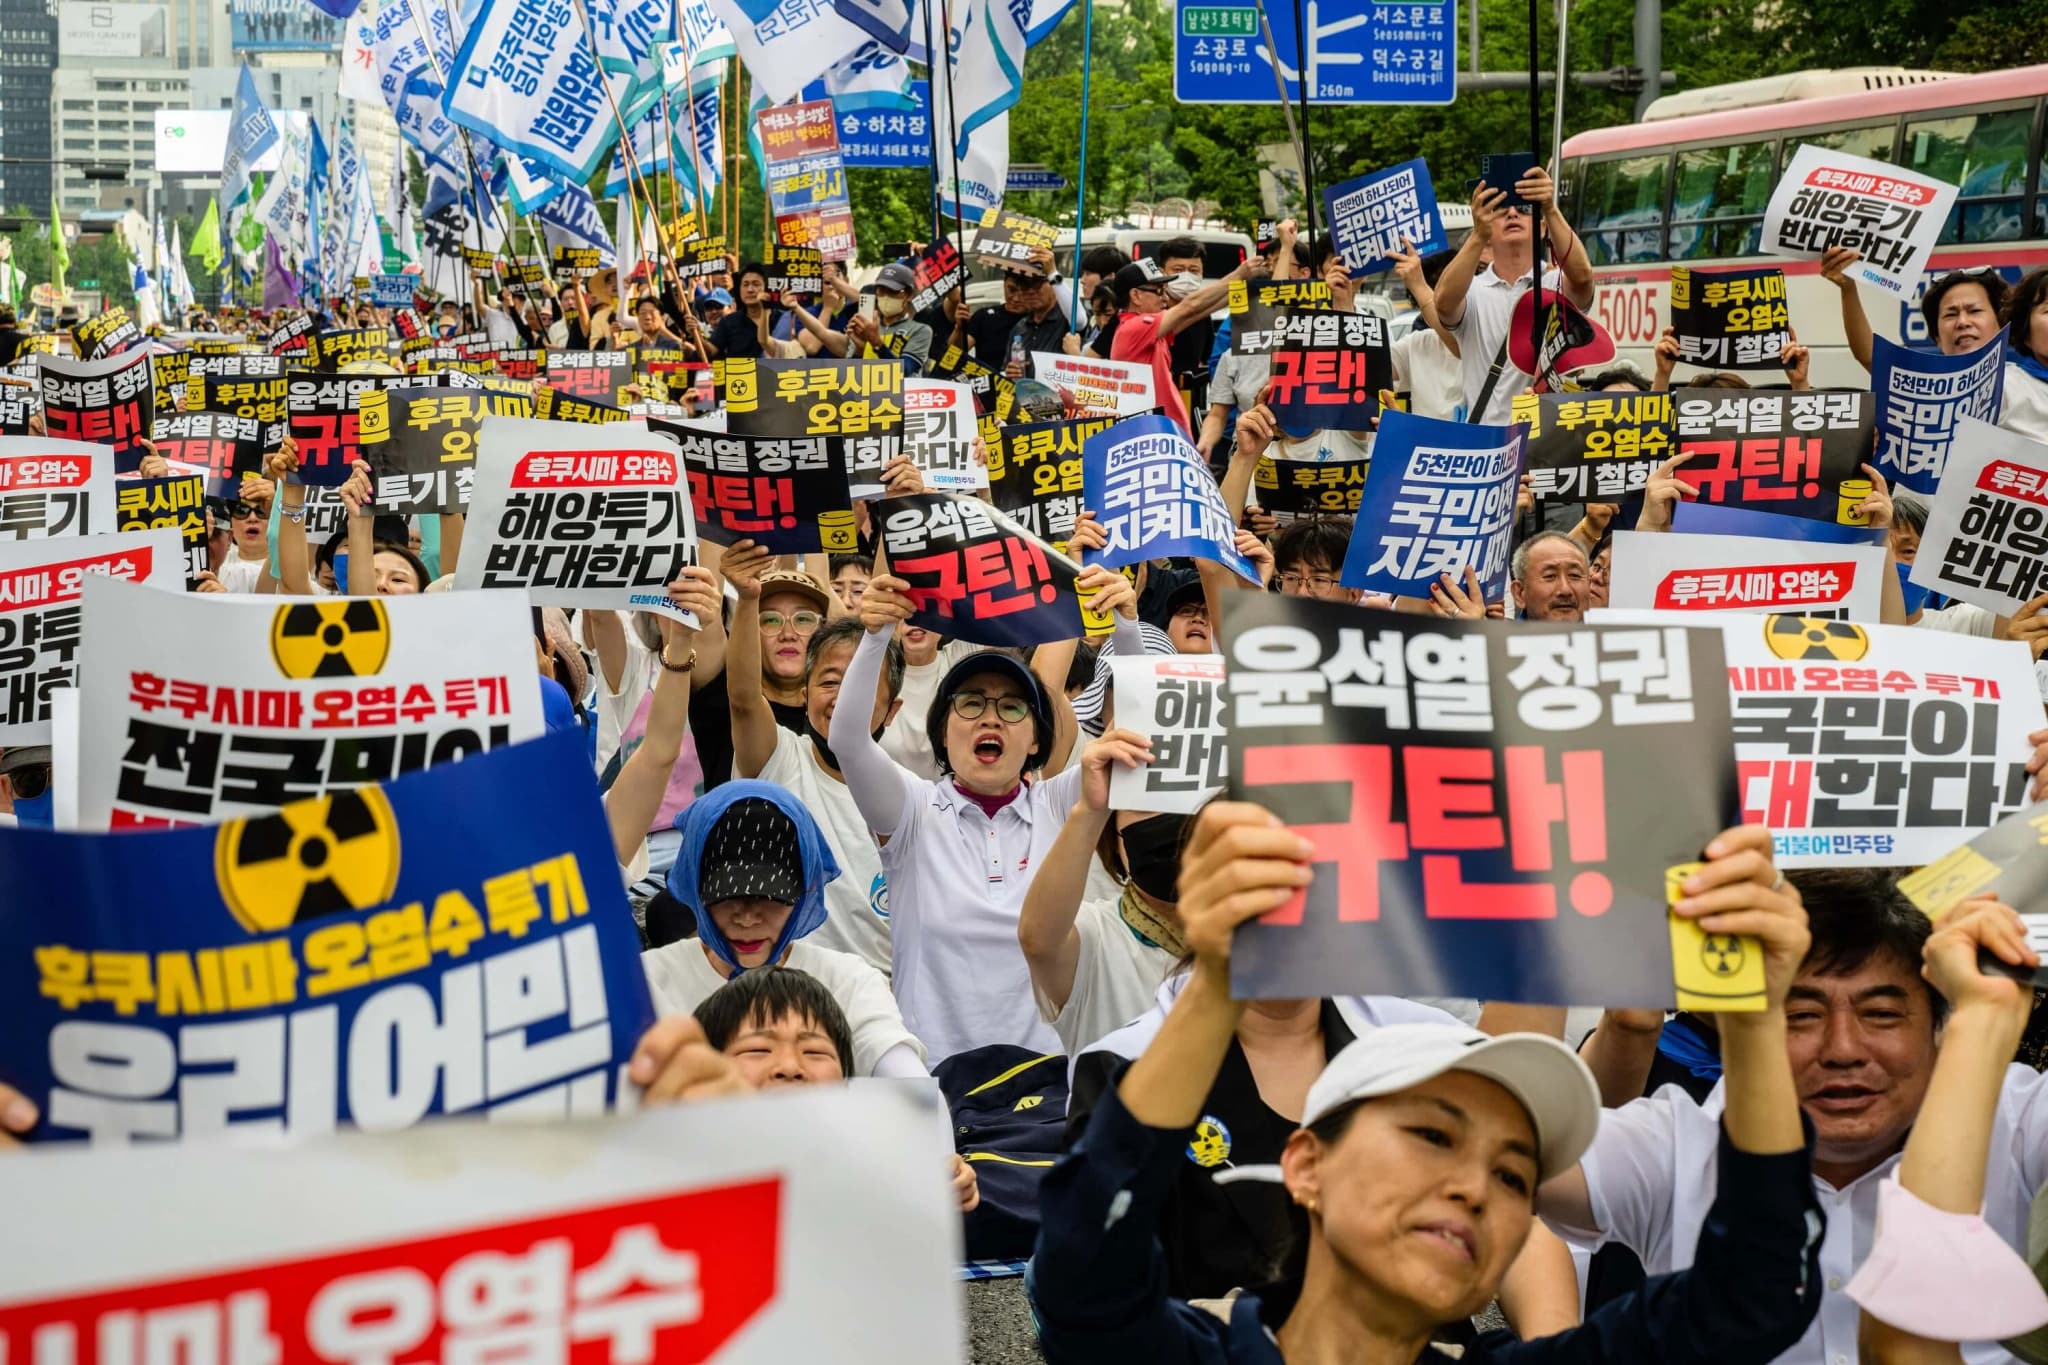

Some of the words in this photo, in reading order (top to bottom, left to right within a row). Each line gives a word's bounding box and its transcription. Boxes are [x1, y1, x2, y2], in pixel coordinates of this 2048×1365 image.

[1188, 12, 1254, 31] 남산3호터널
[1373, 7, 1443, 27] 서소문로
[1193, 40, 1247, 60] 소공로
[1373, 28, 1443, 41] Seosomun-ro
[1190, 60, 1250, 75] Sogong-ro
[1373, 49, 1443, 70] 덕수궁길
[1320, 84, 1354, 98] 260m
[1373, 70, 1443, 84] Deoksugung-gil
[1335, 193, 1366, 216] 5천만이
[1366, 173, 1411, 203] 하나되어
[1814, 167, 1877, 193] 후쿠시마
[1873, 179, 1925, 203] 오염수
[1002, 216, 1058, 240] 후쿠시마
[1337, 189, 1420, 243] 국민안전
[1788, 187, 1923, 240] 해양투기
[777, 248, 822, 262] 후쿠시마
[976, 239, 1008, 256] 투기
[1340, 211, 1432, 270] 지켜내자!
[768, 277, 789, 292] 투기
[786, 263, 821, 277] 오염수
[1862, 269, 1903, 293] 더불어민주당
[1702, 275, 1786, 308] 후쿠시마
[1274, 315, 1340, 347] 윤석열
[1343, 316, 1383, 347] 정권
[1725, 304, 1788, 332] 오염수
[323, 329, 389, 356] 후쿠시마
[1679, 336, 1729, 364] 투기
[188, 357, 241, 376] 윤석열
[244, 356, 279, 375] 정권
[547, 352, 593, 368] 윤석열
[596, 351, 627, 366] 정권
[43, 375, 110, 408] 윤석열
[112, 360, 149, 400] 정권
[548, 368, 610, 396] 규탄!
[776, 361, 905, 402] 후쿠시마
[1268, 350, 1367, 405] 규탄!
[1892, 366, 1954, 396] 5천만이
[408, 386, 538, 431] 후쿠시마
[560, 401, 629, 424] 후쿠시마
[904, 391, 948, 407] 오염수
[1073, 390, 1118, 410] 반드시
[1556, 393, 1673, 430] 후쿠시마
[1677, 397, 1783, 436] 윤석열
[1790, 393, 1861, 432] 정권
[153, 414, 213, 440] 윤석열
[217, 416, 259, 441] 정권
[806, 399, 903, 434] 오염수
[753, 436, 829, 472] 정권
[1111, 438, 1176, 470] 5천만이
[1583, 427, 1669, 459] 오염수
[17, 457, 81, 485] 오염수
[524, 455, 620, 482] 후쿠시마
[622, 455, 673, 482] 오염수
[1412, 453, 1492, 479] 5천만이
[1528, 465, 1589, 499] 투기
[1672, 436, 1824, 502] 규탄!
[375, 470, 447, 511] 투기
[1388, 476, 1516, 536] 국민안전
[497, 491, 686, 541] 해양투기
[885, 500, 1000, 554] 윤석열
[895, 536, 1058, 620] 규탄!
[1670, 570, 1776, 606] 후쿠시마
[1778, 570, 1840, 602] 오염수
[1229, 625, 1495, 732] 윤석열
[1506, 626, 1696, 733] 정권
[1803, 666, 1918, 694] 오염수
[1924, 672, 2001, 701] 투기
[128, 671, 304, 729] 후쿠시마
[311, 682, 437, 730] 오염수
[444, 675, 512, 720] 투기
[1243, 743, 1615, 927] 규탄!
[1773, 834, 1895, 856] 더불어민주당
[34, 937, 299, 1018] 후쿠시마
[302, 888, 487, 999] 오염수
[481, 851, 591, 940] 투기
[48, 922, 614, 1142] 우리어민
[305, 1222, 706, 1365] 오염수
